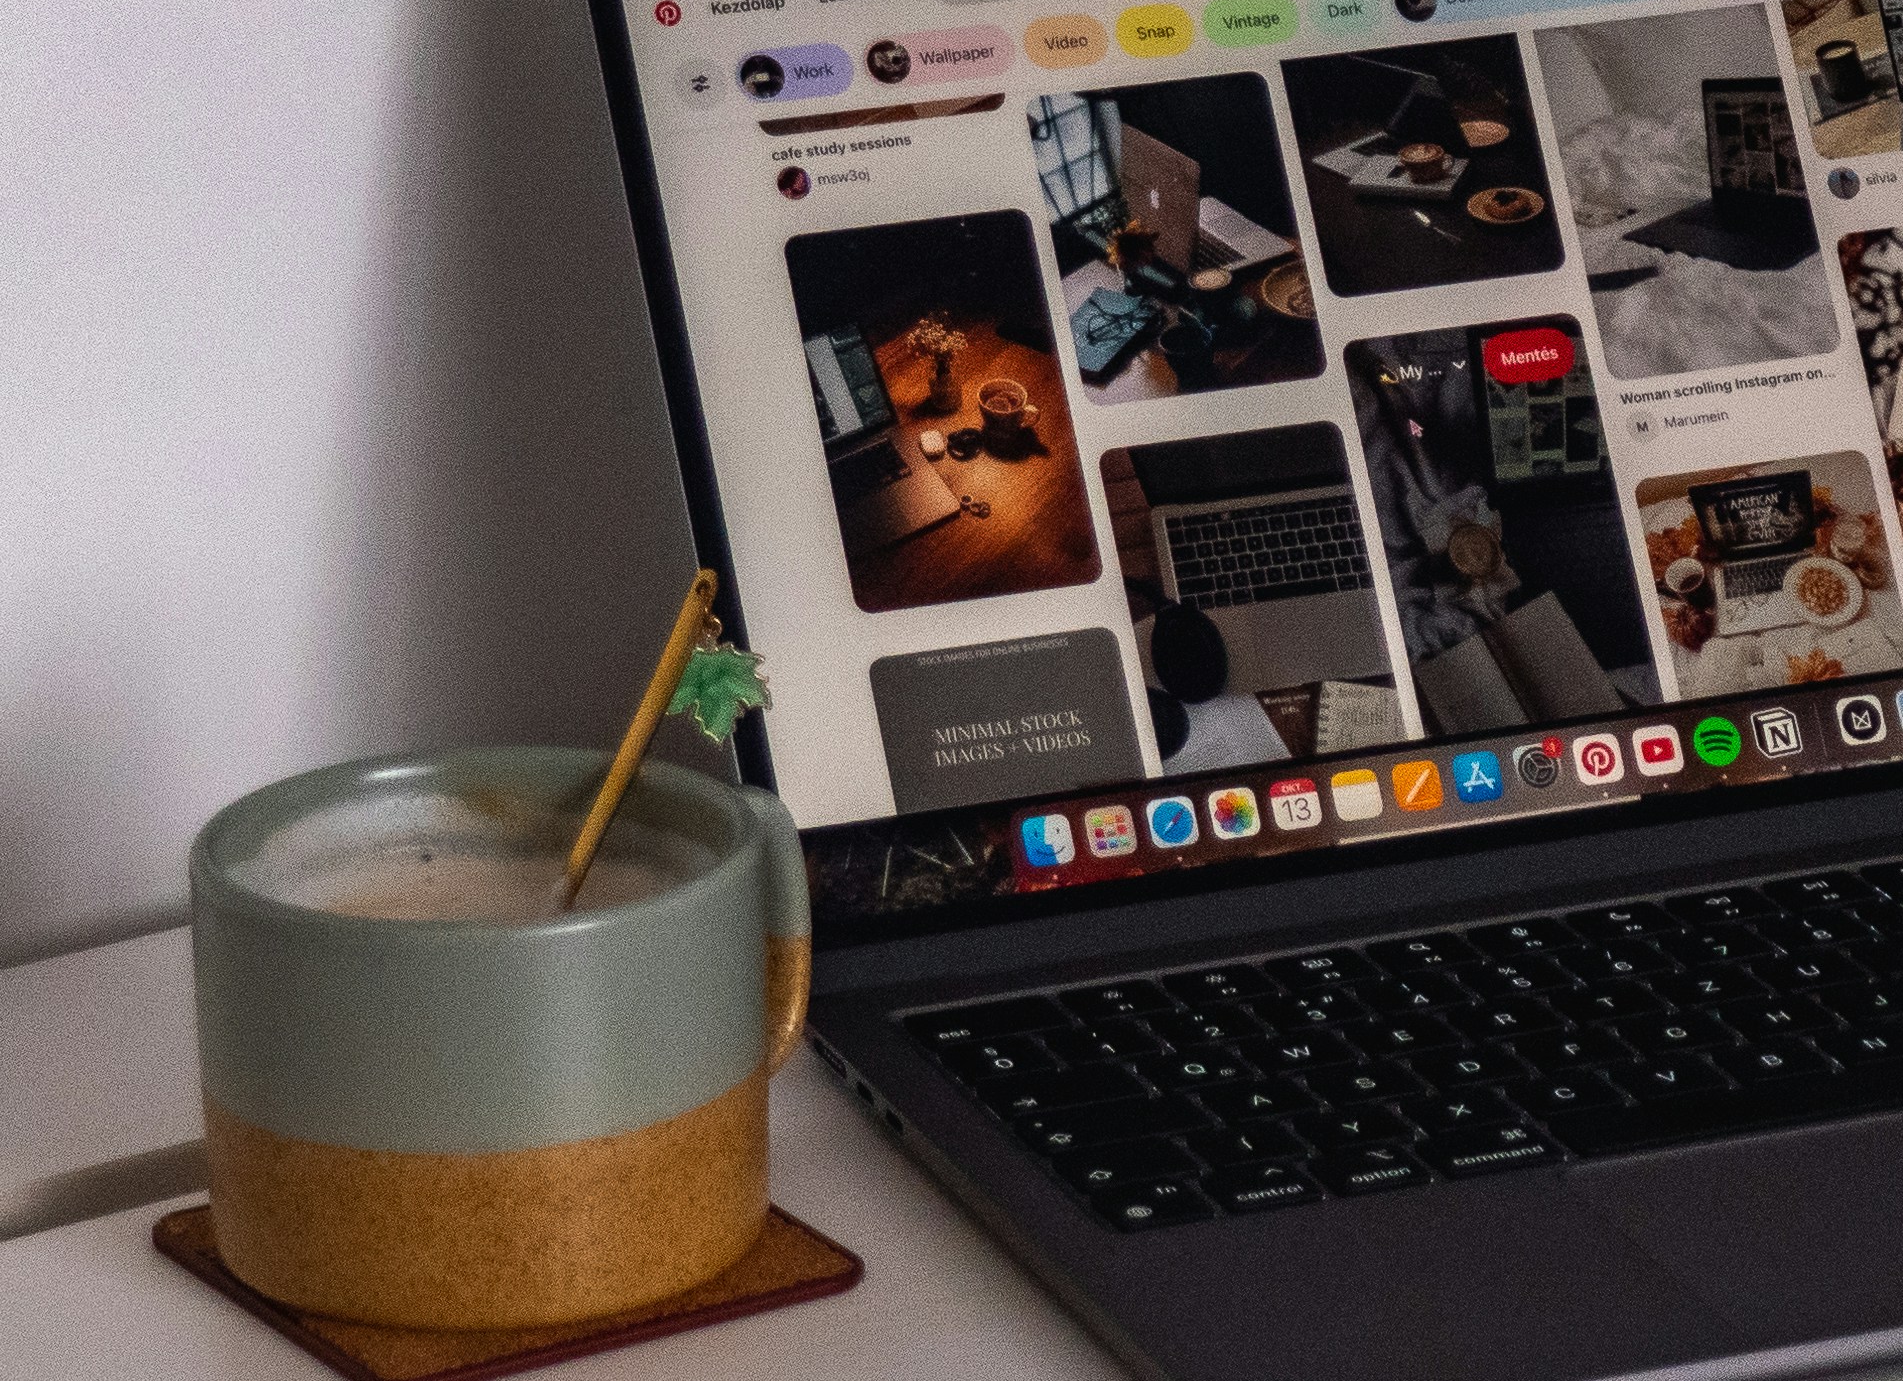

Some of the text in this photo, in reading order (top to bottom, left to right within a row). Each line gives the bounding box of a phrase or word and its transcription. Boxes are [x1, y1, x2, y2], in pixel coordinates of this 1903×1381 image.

[1327, 2, 1362, 19] Dark
[1222, 12, 1280, 32] Vintage
[1044, 35, 1088, 51] Video
[1136, 24, 1176, 43] Snap
[919, 46, 995, 66] Wallpaper
[792, 62, 834, 81] Work
[771, 134, 912, 161] cafe study sessions
[1865, 172, 1898, 186] silvia
[1500, 346, 1559, 366] Mentés
[1400, 364, 1424, 381] My
[1620, 389, 1671, 405] Woman
[1674, 381, 1733, 398] scrolling
[1735, 372, 1803, 390] Instagram
[1636, 422, 1649, 433] M
[1664, 410, 1730, 429] Marumein
[932, 709, 1083, 744] MINIMAL STOCK
[934, 743, 1005, 767] IMAGES
[1023, 730, 1092, 753] VIDEOS
[1281, 797, 1312, 823] 13
[1453, 1144, 1545, 1167] command
[1351, 1166, 1412, 1184] option
[1236, 1182, 1304, 1203] control
